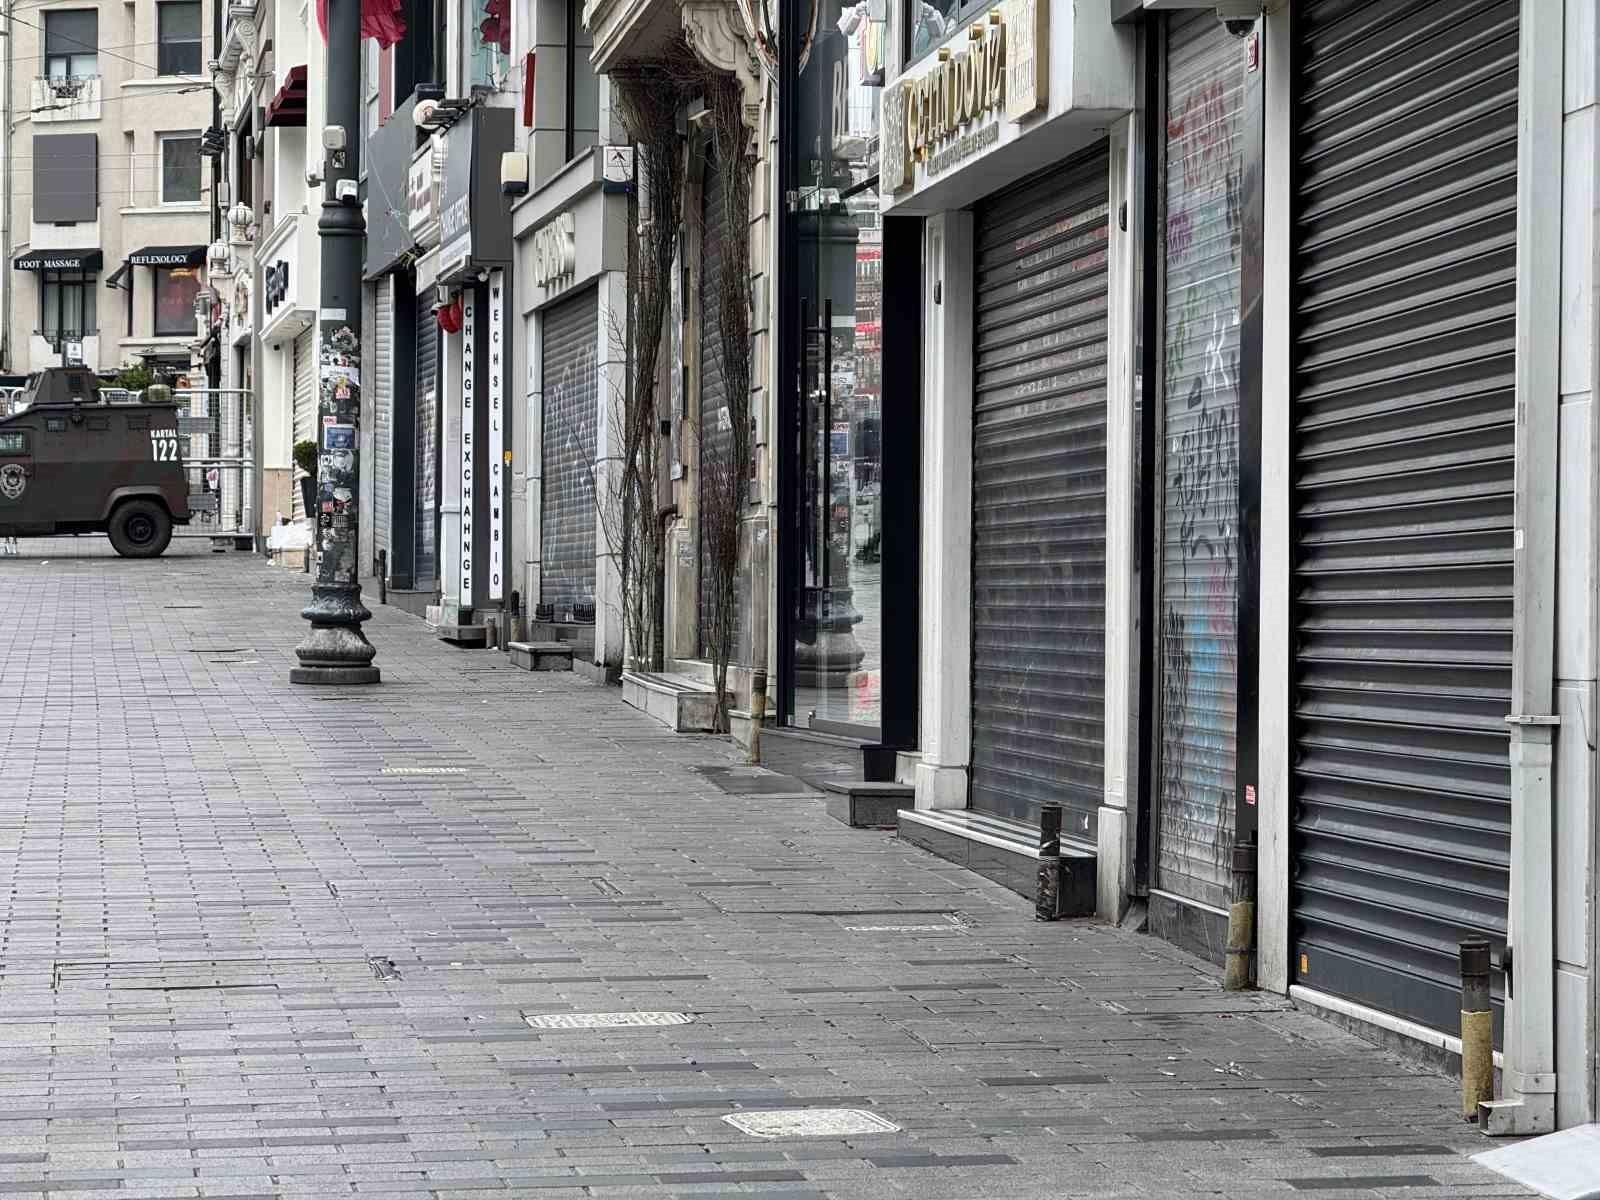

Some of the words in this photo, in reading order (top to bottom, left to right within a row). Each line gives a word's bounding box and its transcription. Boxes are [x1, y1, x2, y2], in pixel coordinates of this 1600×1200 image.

[19, 260, 40, 269] FOOT
[44, 259, 80, 268] MASSAGE
[131, 255, 188, 264] REFLEXOLOGY
[464, 306, 472, 408] CHANGE
[492, 287, 500, 431] WECHSEL
[150, 429, 177, 439] KARTAL
[151, 439, 177, 462] 122
[463, 433, 471, 589] EXCHAHNGE
